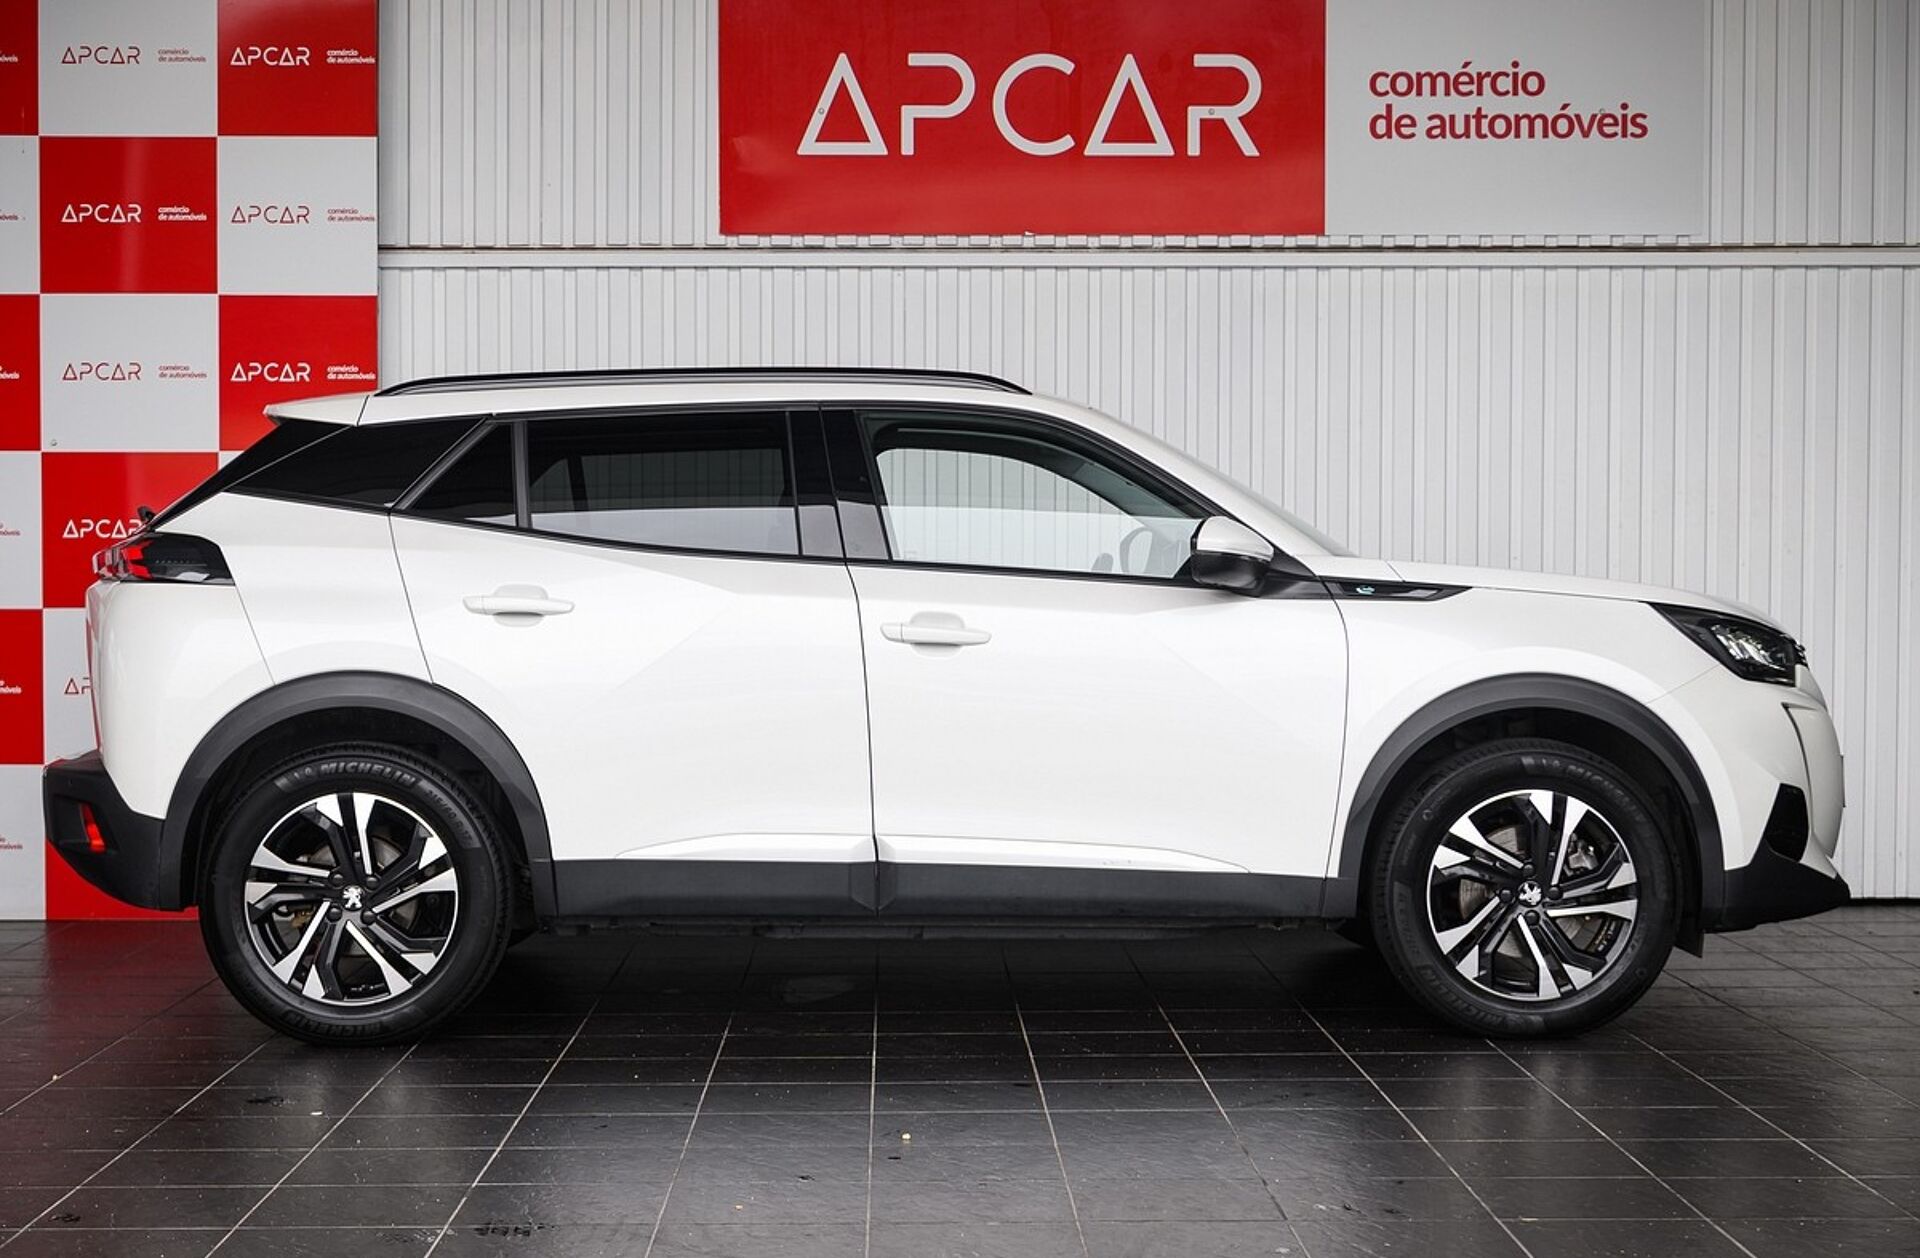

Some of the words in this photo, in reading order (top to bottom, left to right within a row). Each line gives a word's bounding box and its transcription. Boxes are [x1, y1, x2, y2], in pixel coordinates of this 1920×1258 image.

[61, 46, 141, 65] APCAR
[230, 47, 310, 66] APCAR
[1369, 61, 1546, 97] comércio
[797, 52, 1262, 156] APCAR
[1369, 103, 1417, 139] de
[1425, 102, 1648, 139] automóveis
[61, 204, 141, 223] APCAR
[230, 205, 310, 224] APCAR
[62, 362, 142, 381] APCAR
[230, 362, 311, 382] APCAR
[320, 762, 417, 786] MICHELIN
